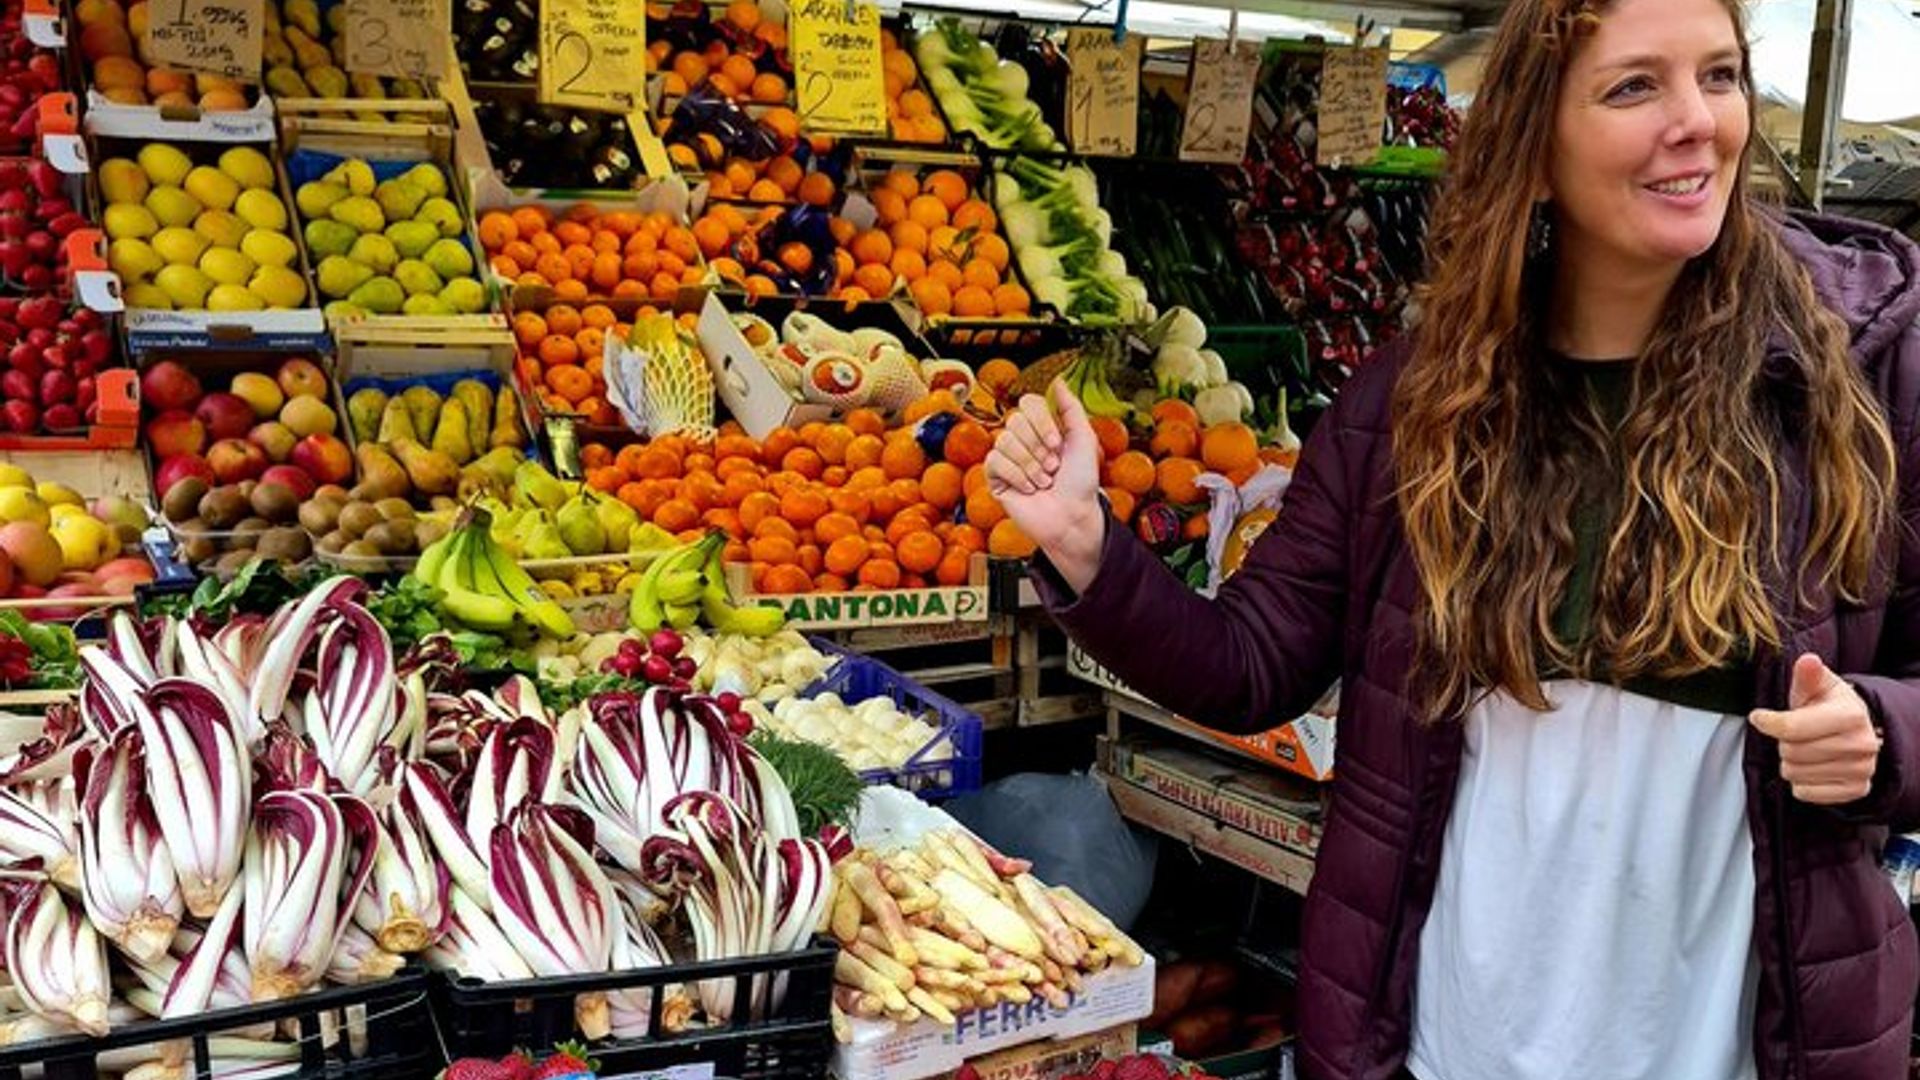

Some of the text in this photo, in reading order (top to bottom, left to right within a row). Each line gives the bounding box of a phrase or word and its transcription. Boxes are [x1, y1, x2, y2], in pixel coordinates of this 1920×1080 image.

[360, 17, 392, 67] 3
[554, 30, 606, 98] 2
[798, 70, 853, 122] 2
[1184, 103, 1218, 153] 2
